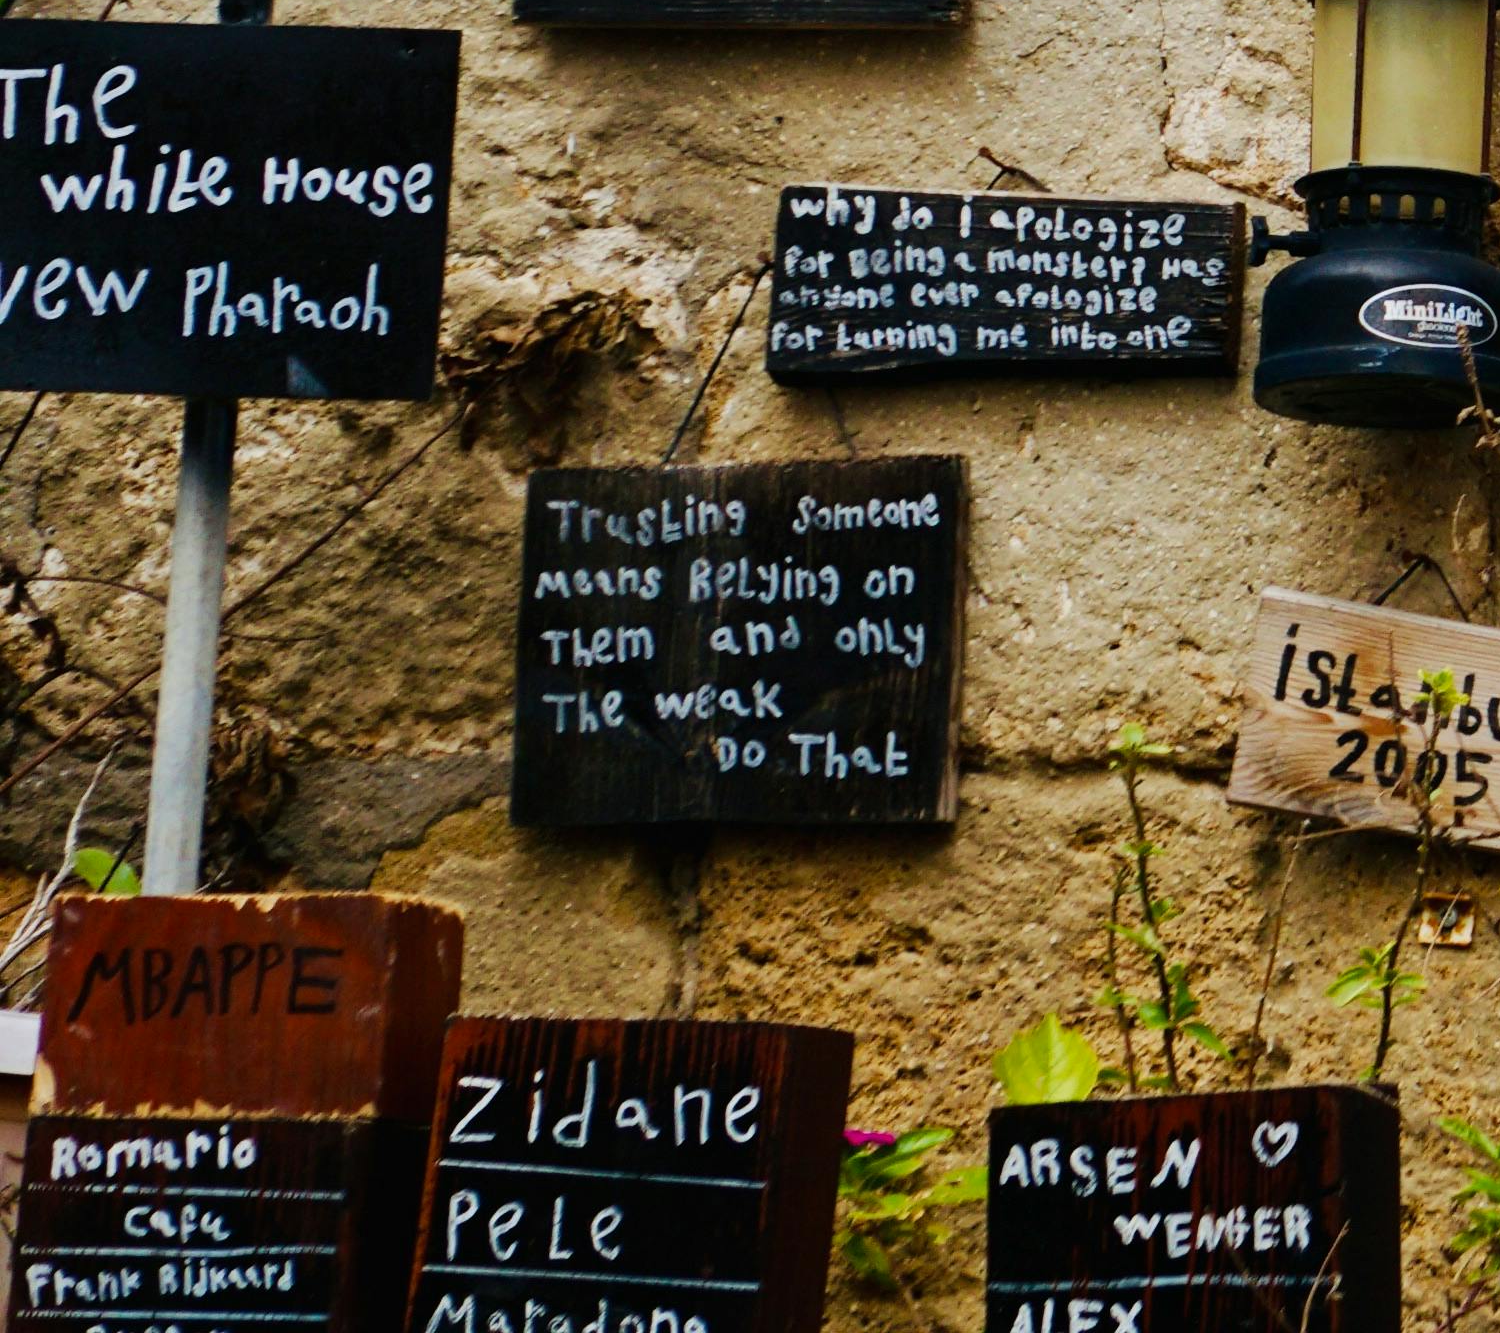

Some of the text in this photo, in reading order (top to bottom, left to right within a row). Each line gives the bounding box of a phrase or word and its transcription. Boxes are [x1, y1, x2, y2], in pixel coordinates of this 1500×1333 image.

[0, 63, 138, 144] The
[40, 144, 231, 213] white
[892, 198, 932, 229] do
[978, 326, 1027, 348] me
[864, 565, 914, 600] on
[710, 616, 800, 656] and
[542, 690, 623, 733] The
[66, 942, 343, 1025] MBAPPE
[449, 1059, 760, 1148] Zidane
[1000, 1137, 1200, 1197] ARSEN
